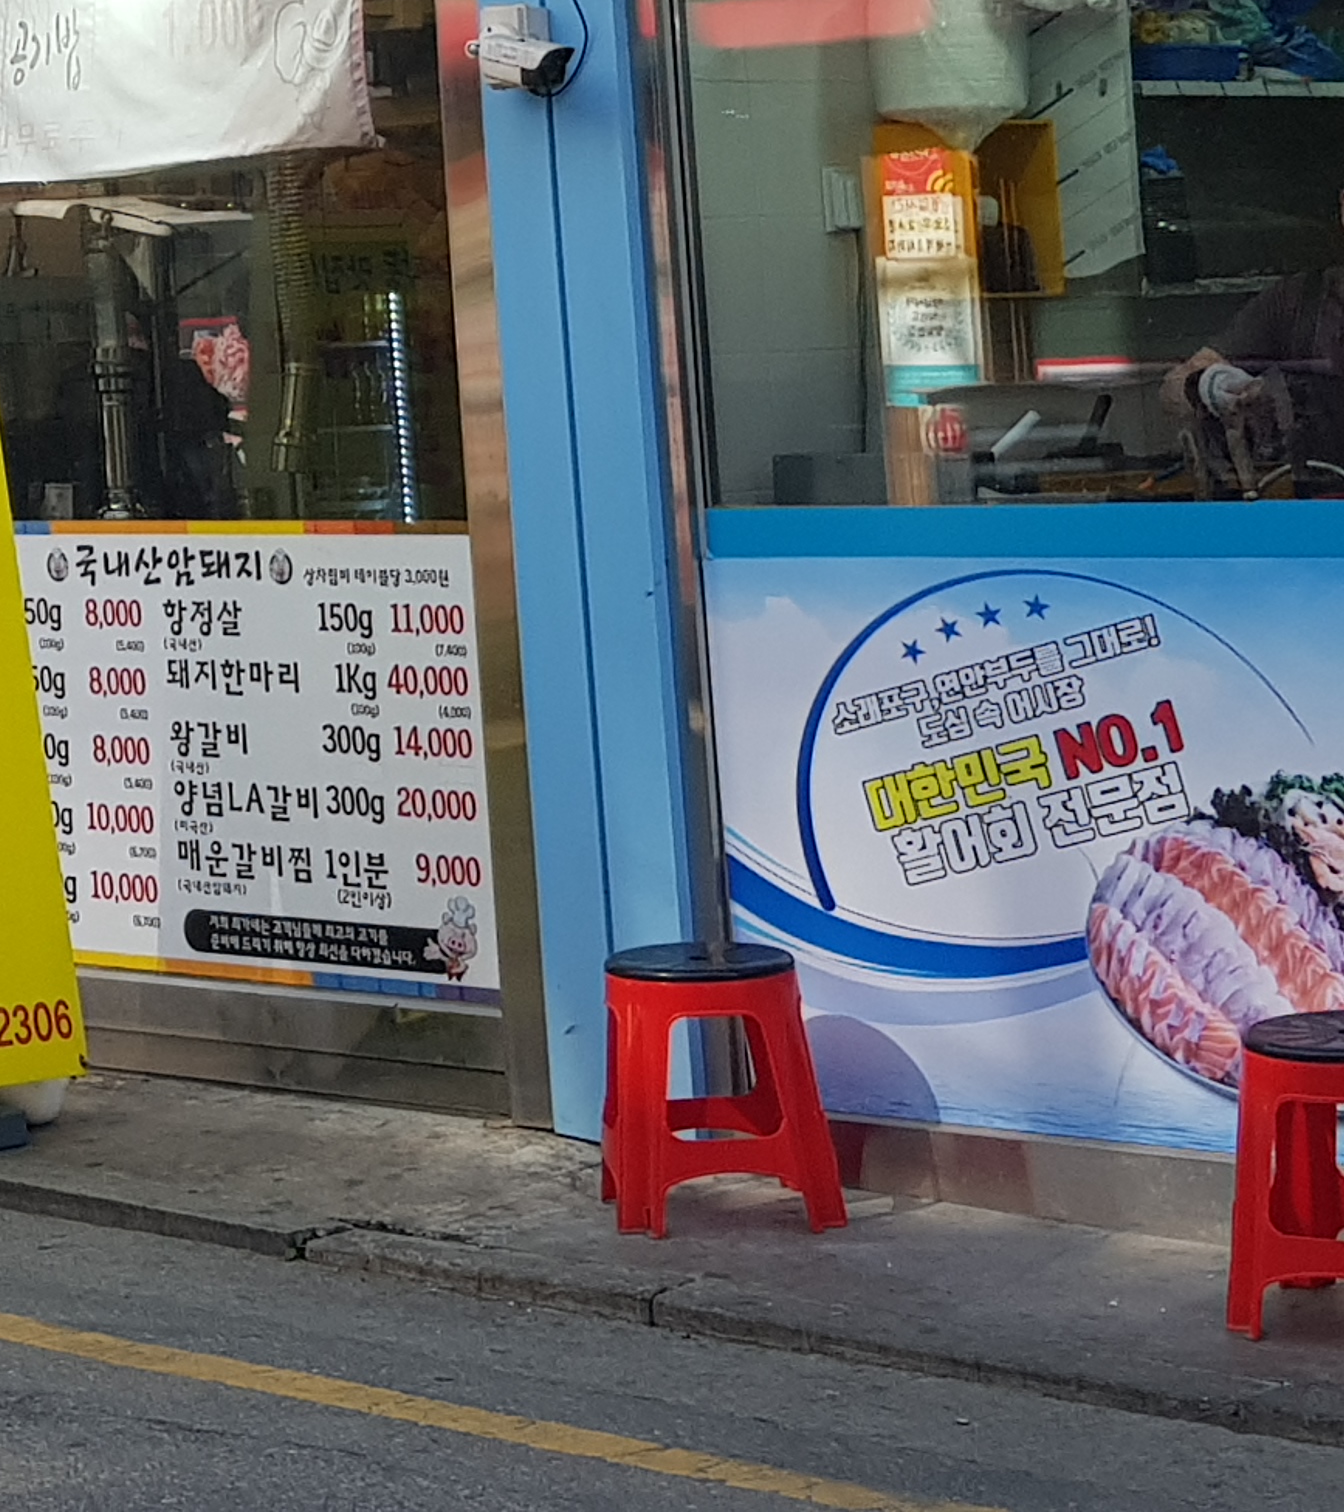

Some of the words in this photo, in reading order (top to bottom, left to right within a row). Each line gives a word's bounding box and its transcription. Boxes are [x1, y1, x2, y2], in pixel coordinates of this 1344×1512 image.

[74, 543, 263, 587] 국내산암돼지
[23, 597, 62, 632] 50g
[84, 598, 142, 631] 8,000
[162, 599, 243, 637] 항정살
[317, 602, 374, 639] 150g
[389, 603, 465, 637] 11,000
[1064, 613, 1161, 669] 그대로!
[88, 665, 147, 699] 8,000
[166, 658, 300, 697] 돼지한마리
[334, 662, 378, 701] 1Kg
[387, 663, 469, 699] 40,000
[916, 702, 974, 749] 도심
[973, 698, 1004, 729] 속
[1003, 674, 1086, 726] 어시장
[43, 732, 70, 768] 0g
[92, 733, 151, 767] 8,000
[169, 719, 249, 759] 왕갈비
[321, 723, 382, 762] 300g
[393, 724, 474, 760] 14,000
[862, 734, 1053, 832] 대한민국
[1054, 698, 1186, 782] NO.1
[86, 801, 155, 836] 10,000
[325, 785, 386, 824] 300g
[396, 787, 478, 823] 20,000
[890, 800, 1039, 887] 활어회
[1037, 760, 1192, 850] 전문점
[177, 839, 314, 885] 매운갈비찜
[325, 848, 390, 890] 1인분
[415, 853, 482, 888] 9,000
[90, 869, 159, 905] 10,000
